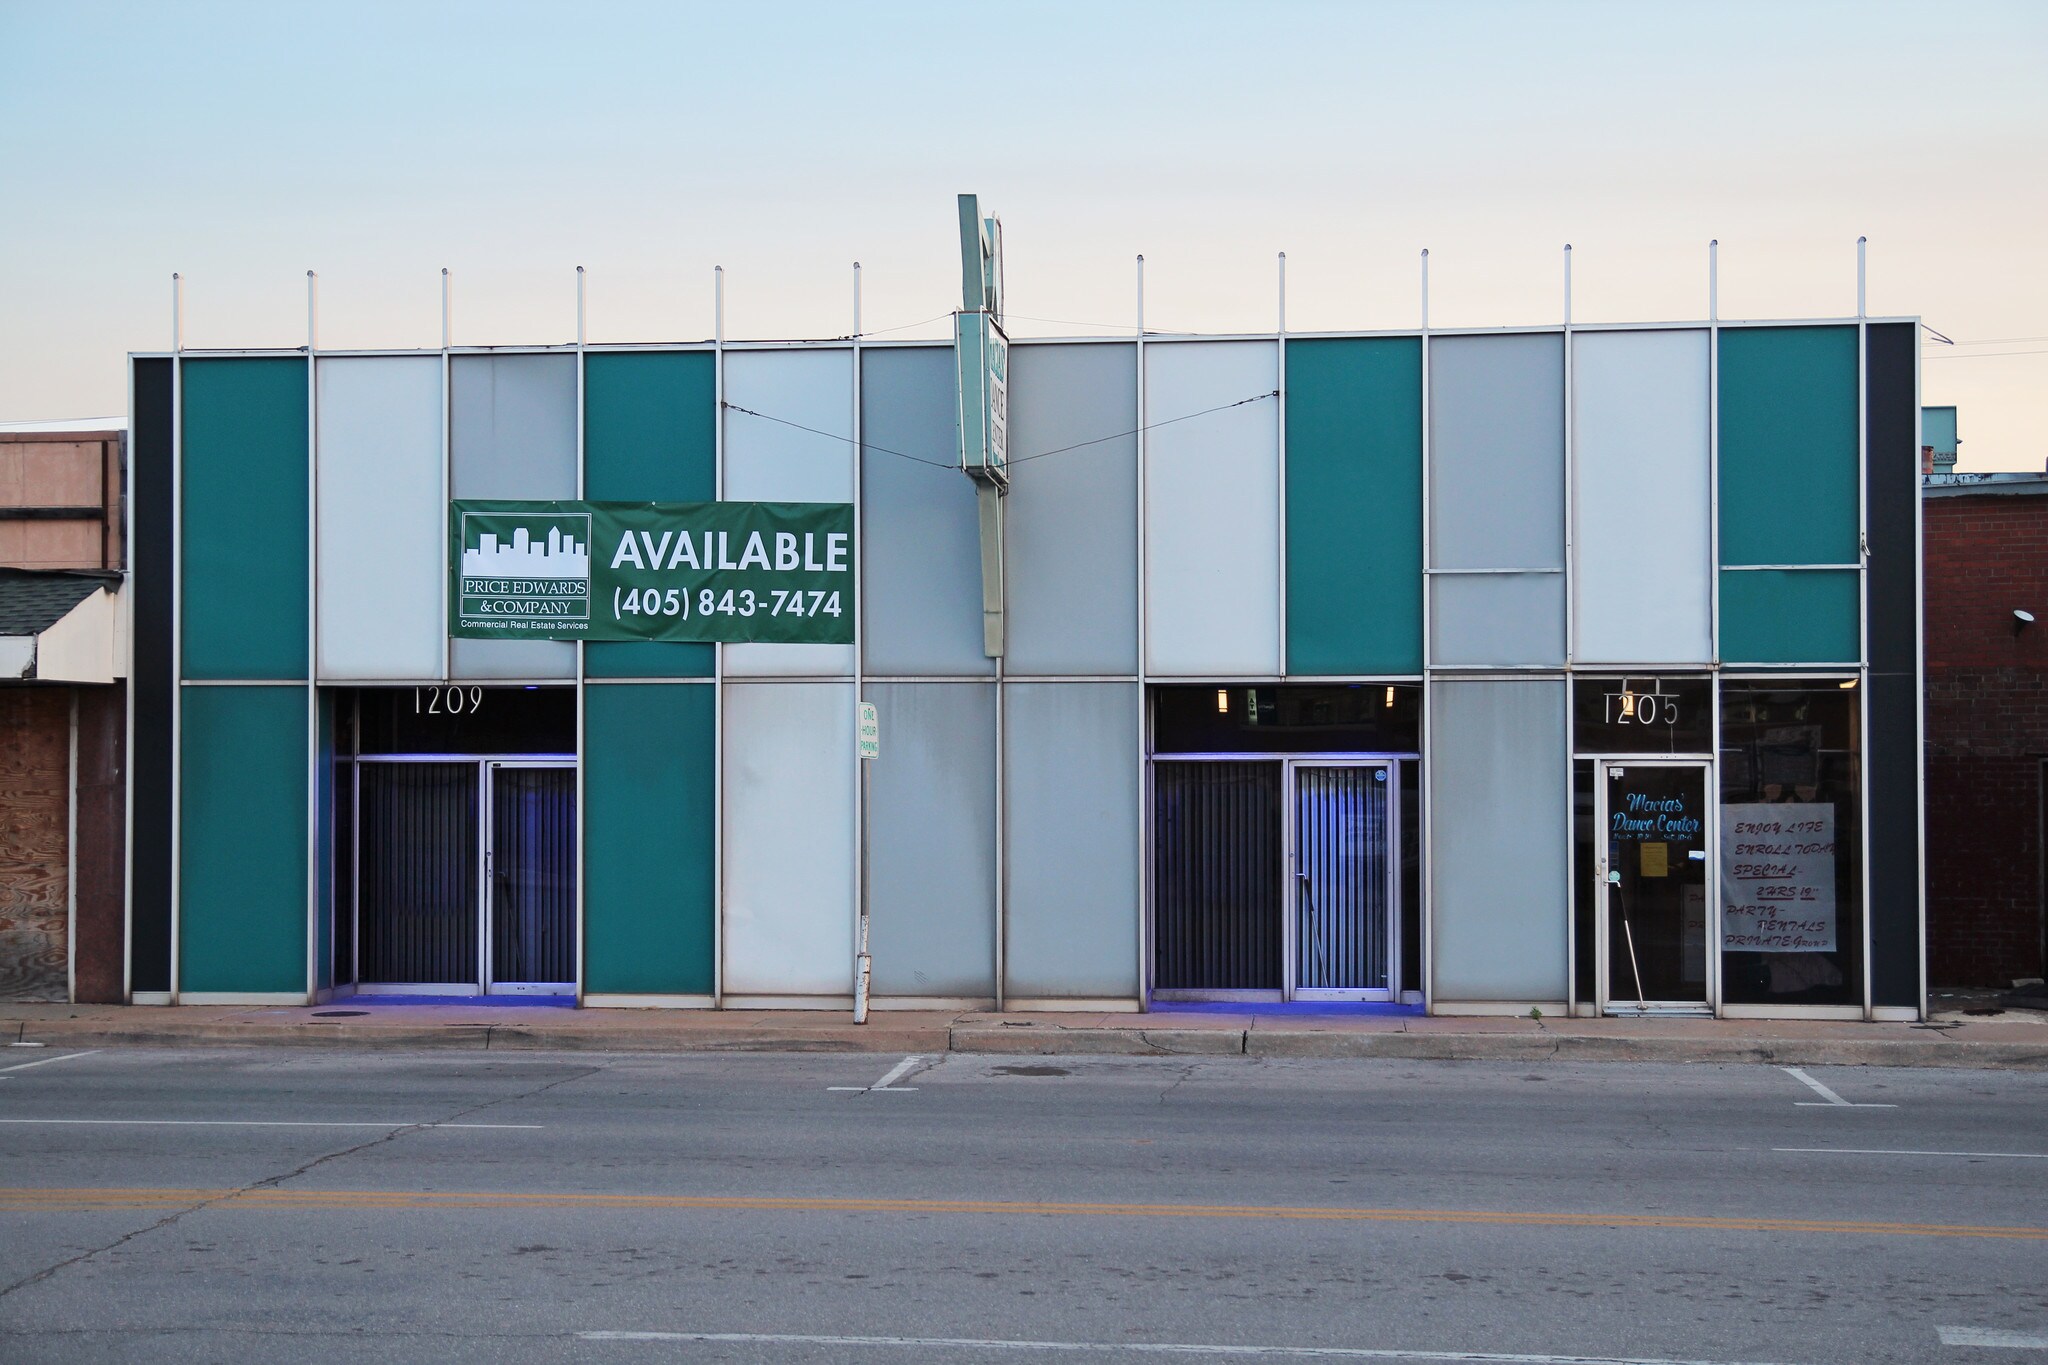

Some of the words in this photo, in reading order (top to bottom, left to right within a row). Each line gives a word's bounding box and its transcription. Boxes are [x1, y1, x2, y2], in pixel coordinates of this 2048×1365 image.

[610, 530, 848, 572] AVAILABLE
[464, 580, 509, 593] PRICE
[513, 581, 586, 594] EDWARDS
[480, 600, 571, 614] &COMPANY
[613, 586, 690, 620] (405)
[698, 590, 842, 618] 843-7474
[461, 620, 508, 628] Commercial
[510, 621, 528, 629] Real
[531, 621, 555, 630] Estate
[557, 622, 588, 630] Services
[416, 686, 482, 714] 1209
[864, 709, 875, 721] ONE
[1604, 694, 1678, 725] 1205
[861, 725, 877, 736] HOUR
[860, 740, 878, 752] PARKING
[1612, 812, 1654, 831] Dance
[1657, 814, 1700, 832] Center
[1734, 822, 1782, 835] ENJOY
[1785, 821, 1824, 833] LIFE
[1735, 844, 1792, 855] ENROLL
[1757, 919, 1825, 932] RENTALS
